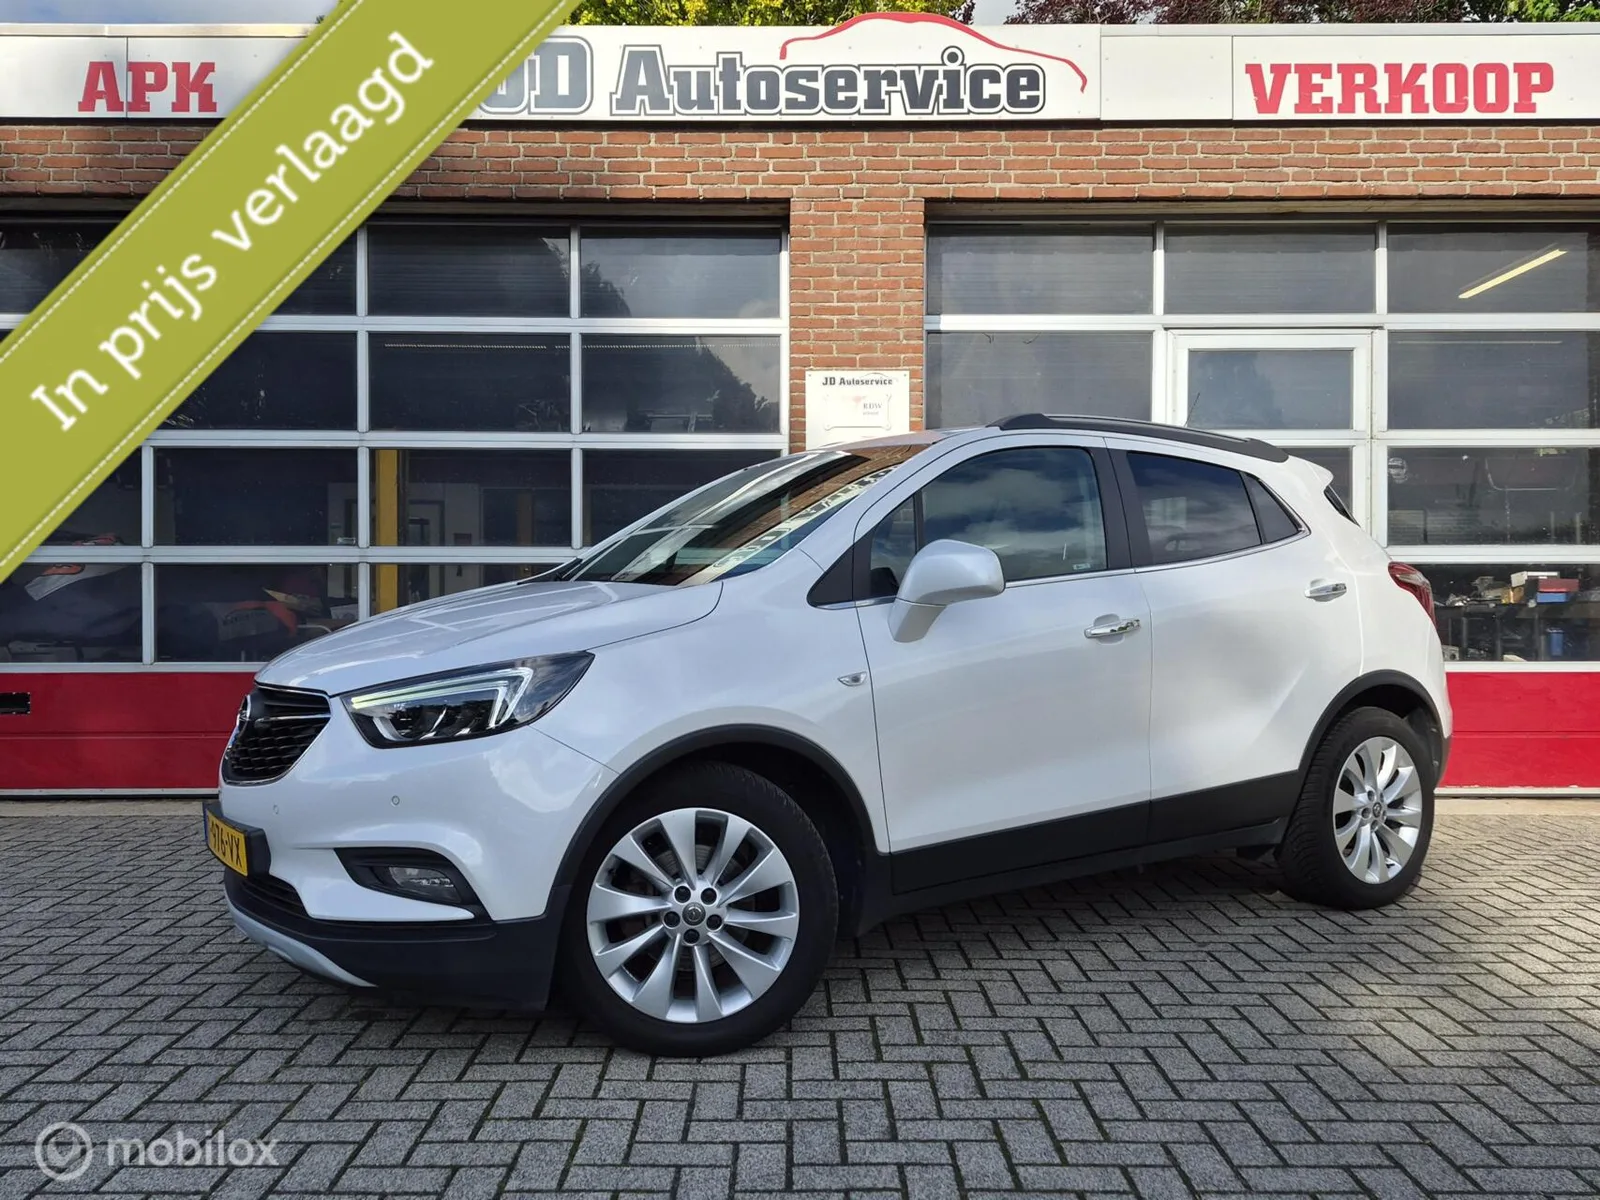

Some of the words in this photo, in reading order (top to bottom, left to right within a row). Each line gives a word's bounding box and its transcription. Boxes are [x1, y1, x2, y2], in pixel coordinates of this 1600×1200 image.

[78, 62, 217, 112] APK
[610, 45, 1046, 116] Autoservice
[1245, 62, 1554, 114] VERKOOP
[822, 377, 835, 386] JD
[839, 377, 892, 386] Autoservice
